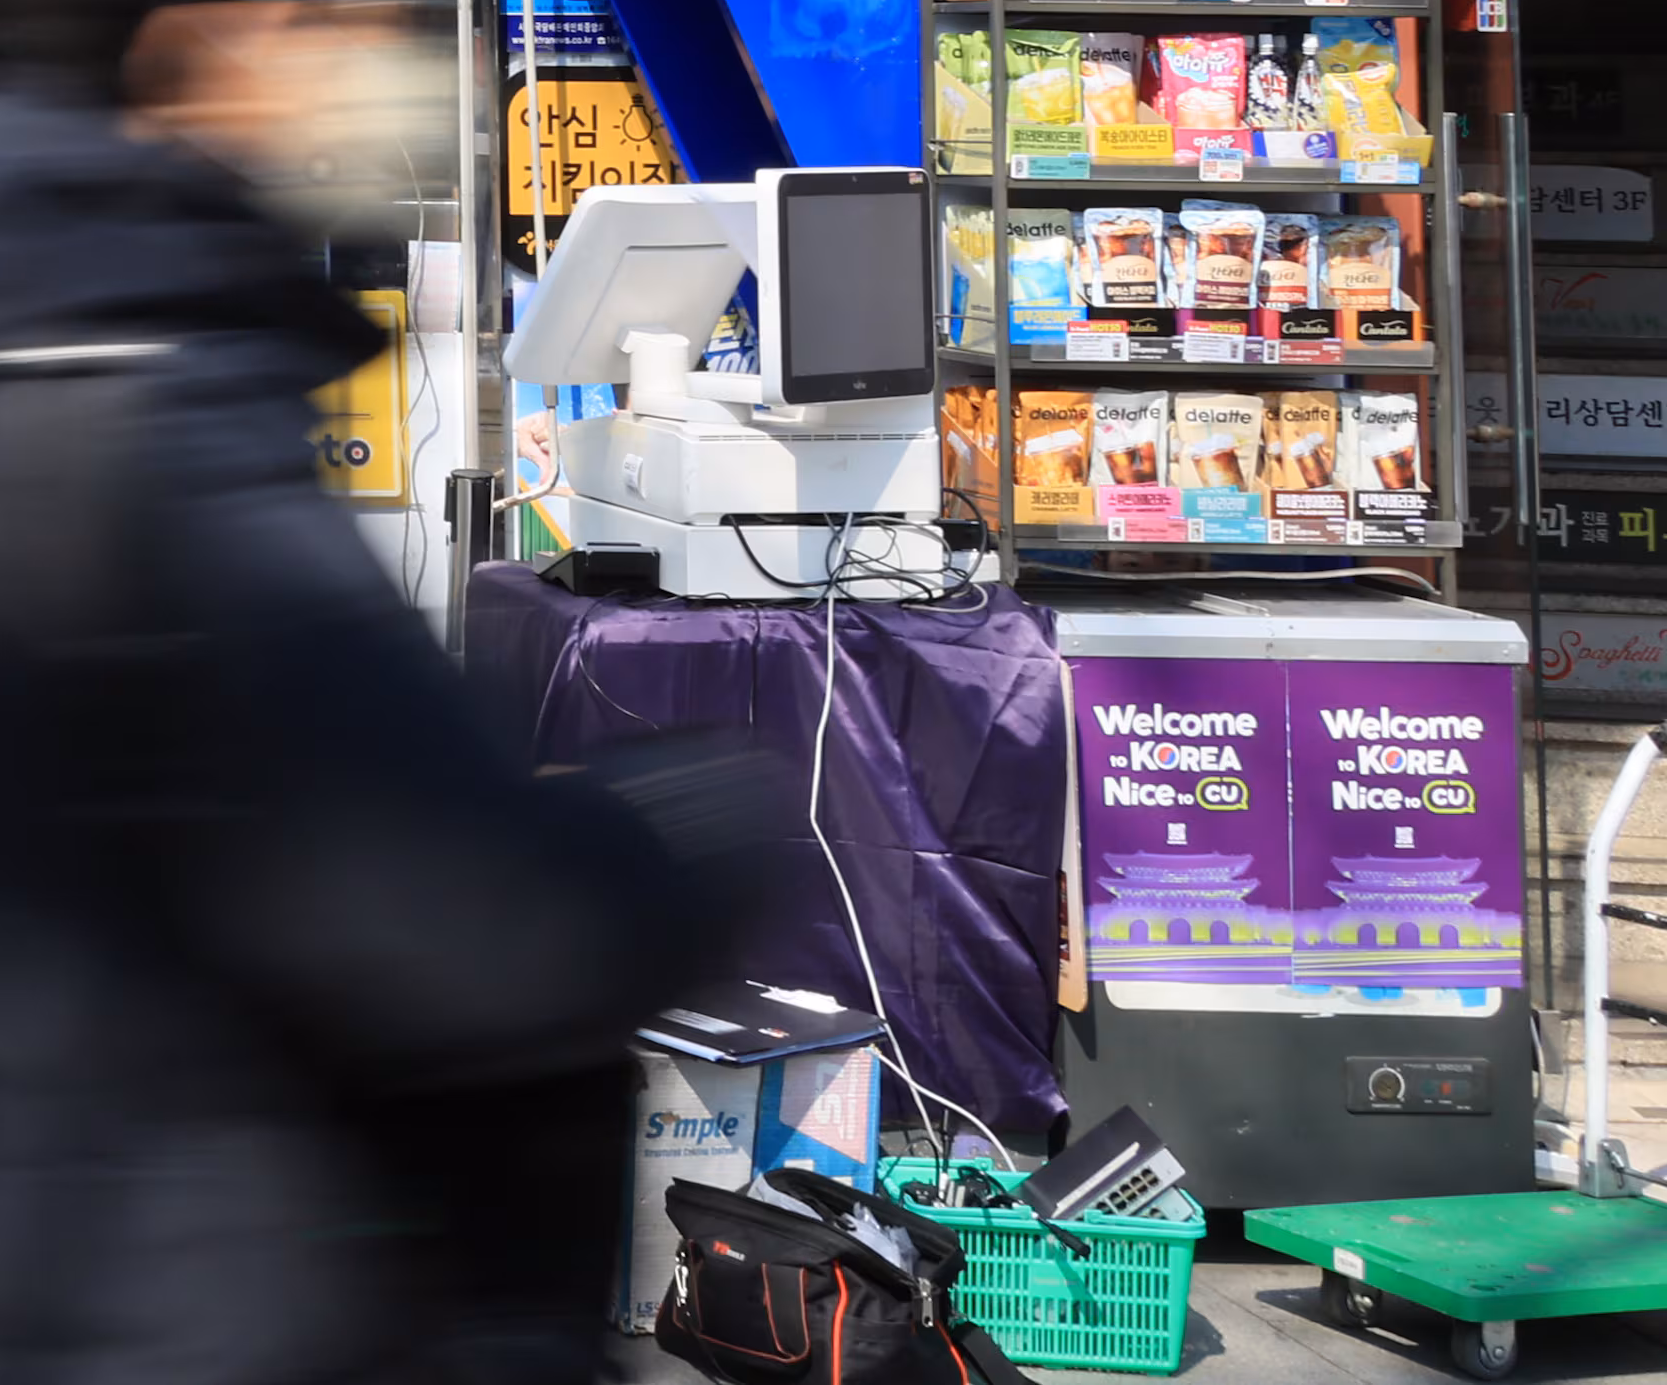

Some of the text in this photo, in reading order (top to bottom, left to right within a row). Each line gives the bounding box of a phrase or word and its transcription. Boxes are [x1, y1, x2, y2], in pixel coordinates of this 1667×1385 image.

[521, 104, 597, 149] 안심
[1613, 190, 1647, 213] 3F
[1359, 320, 1408, 337] Cantata
[1093, 703, 1257, 738] Welcome
[1320, 707, 1484, 742] Welcome
[1110, 742, 1242, 772] to KOREA
[1338, 746, 1468, 776] to KOREA
[1103, 777, 1175, 806] Nice
[1178, 791, 1194, 805] to
[1331, 781, 1402, 811] Nice
[1405, 794, 1421, 809] to
